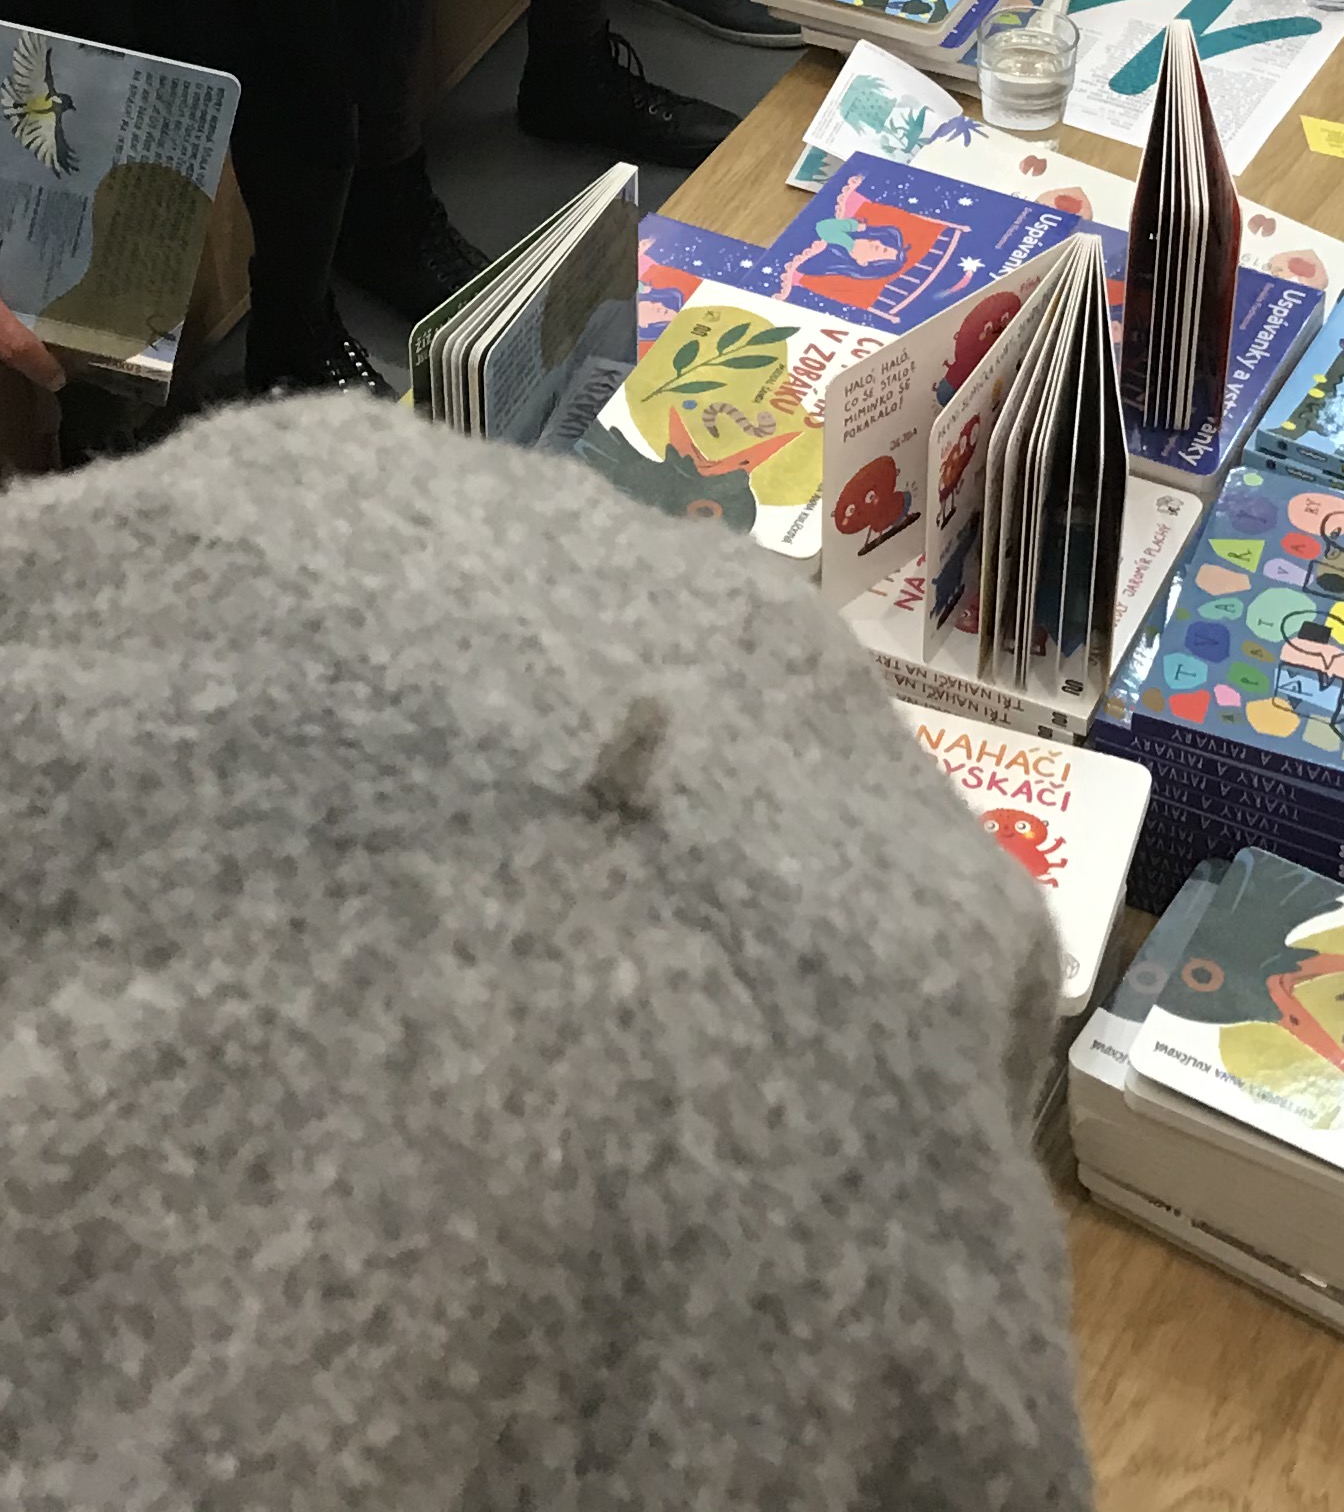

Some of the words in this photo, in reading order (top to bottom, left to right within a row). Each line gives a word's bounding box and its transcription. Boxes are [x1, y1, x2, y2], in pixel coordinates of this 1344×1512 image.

[819, 328, 850, 344] V
[1236, 289, 1307, 371] Uspávanky
[768, 342, 837, 416] ZOBÁKU
[1232, 369, 1251, 381] a
[843, 389, 894, 427] MIMINKO
[897, 379, 912, 396] SE
[844, 397, 859, 413] CO
[862, 387, 875, 404] SE
[893, 672, 914, 688] NA
[906, 665, 928, 680] NA
[921, 682, 979, 715] NAHÁČI
[933, 669, 988, 704] NAHÁČI
[980, 706, 1011, 725] TŘI
[993, 693, 1024, 712] TŘI
[917, 723, 1071, 783] NAHÁČI
[1171, 728, 1247, 759] PATVARY
[1217, 762, 1228, 776] A
[1260, 753, 1271, 766] A
[939, 756, 1071, 813] YSKÁČI
[1281, 764, 1342, 786] TVARY
[1152, 1040, 1213, 1076] KULÍČKOVÁ
